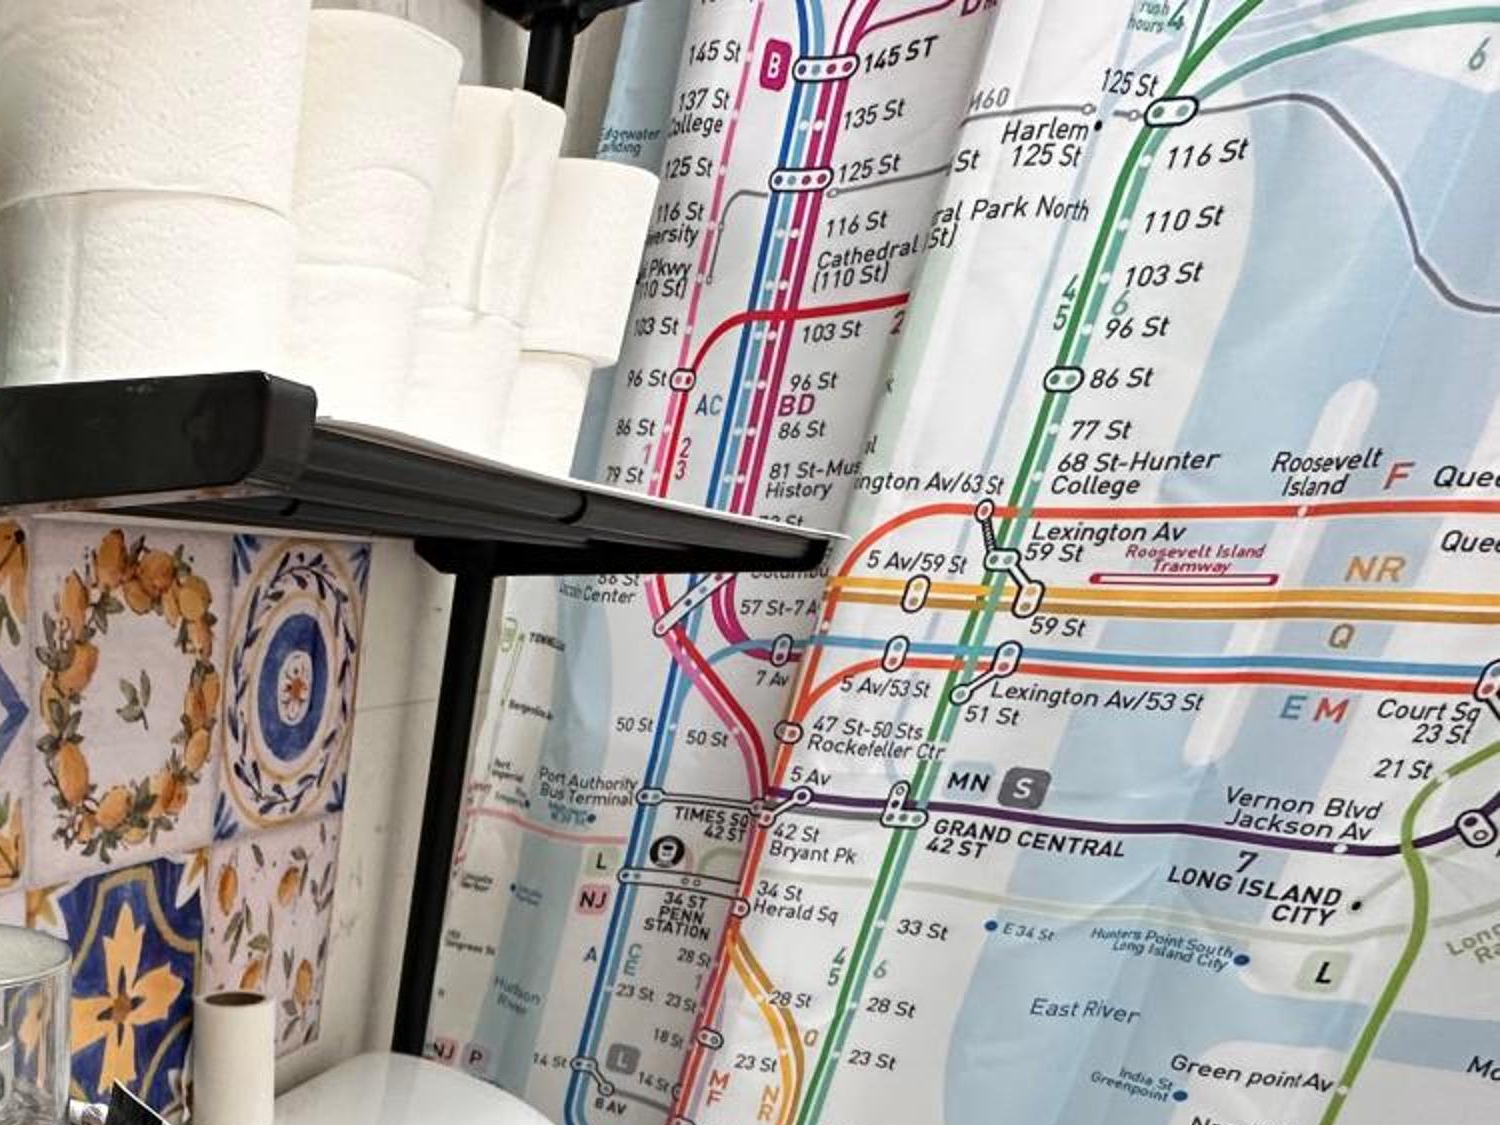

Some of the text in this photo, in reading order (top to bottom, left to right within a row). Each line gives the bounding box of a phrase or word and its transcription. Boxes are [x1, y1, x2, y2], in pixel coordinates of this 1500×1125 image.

[864, 36, 940, 73] 145 ST
[1100, 69, 1160, 98] 125 St
[844, 98, 906, 130] 135 St
[1001, 119, 1089, 145] Harlem
[1011, 144, 1082, 168] 125 St
[1167, 138, 1251, 170] 116 St
[970, 196, 1029, 221] Park
[1035, 194, 1090, 223] North
[1144, 204, 1224, 235] 110 St
[817, 235, 919, 271] Cathedral
[1125, 260, 1204, 289] 103 St
[1089, 366, 1154, 389] 86 St
[777, 394, 816, 418] BD
[1057, 449, 1221, 473] 68 St-Hunter
[1272, 448, 1383, 473] Roosevelt
[1051, 475, 1140, 499] College
[1282, 473, 1350, 497] Island
[1384, 461, 1415, 490] F
[765, 477, 833, 501] History
[1031, 521, 1187, 546] Lexington Av
[867, 550, 968, 575] 5 Av/59 St
[1025, 542, 1086, 564] 59 St
[1125, 543, 1267, 560] Roosevelt Island
[1151, 559, 1233, 576] Tramway
[1328, 623, 1356, 650] Q
[991, 682, 1205, 713] Lexington Av/53 St
[1376, 699, 1482, 727] Court Sq
[1412, 723, 1475, 746] 23 St
[807, 733, 946, 762] Rockefeller Ctr
[948, 771, 992, 792] MN
[1012, 778, 1036, 799] S
[674, 806, 725, 825] TIMES
[1226, 786, 1383, 821] Vernon Blvd
[773, 824, 821, 844] 42 St
[1224, 810, 1373, 842] Jackson Av
[926, 837, 988, 861] 42 ST
[934, 818, 1125, 860] GRAND CENTRAL
[769, 842, 858, 866] Bryant Pk
[1167, 866, 1343, 907] LONG ISLAND
[579, 890, 608, 910] NJ
[658, 904, 705, 924] PENN
[753, 900, 839, 927] Herald Sq
[1271, 904, 1336, 927] CITY
[644, 917, 711, 942] STATION
[896, 919, 950, 941] 33 St
[1030, 998, 1142, 1025] East River
[848, 1049, 896, 1071] 23 St
